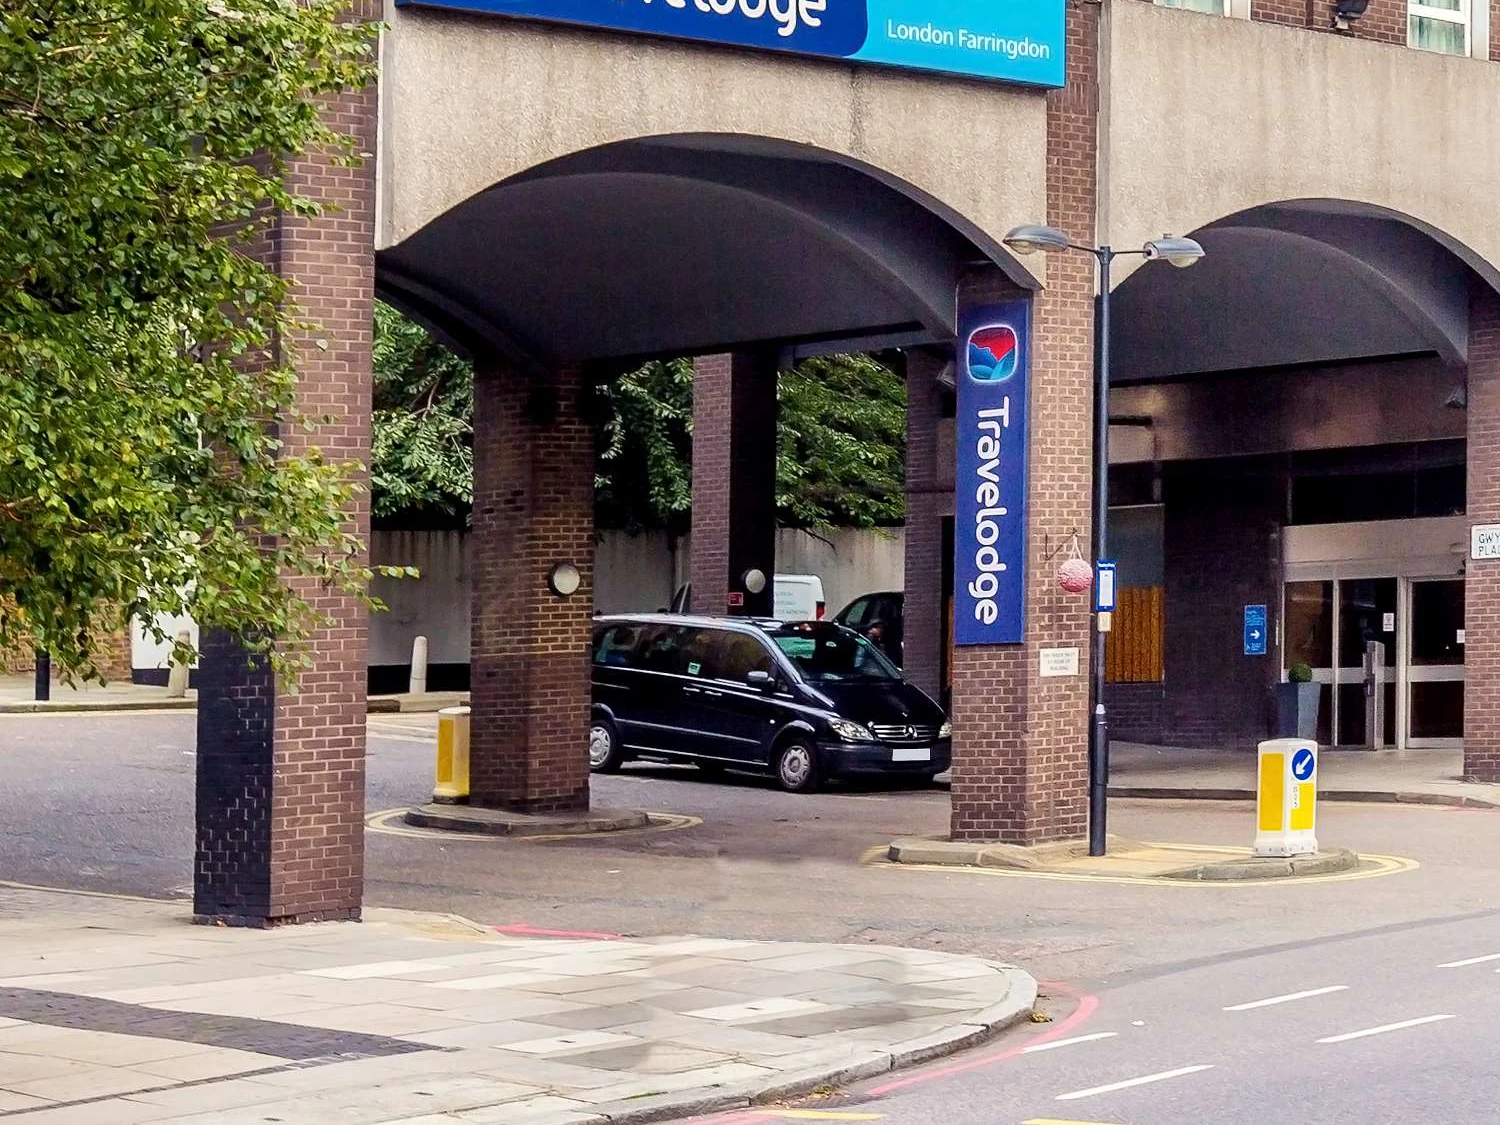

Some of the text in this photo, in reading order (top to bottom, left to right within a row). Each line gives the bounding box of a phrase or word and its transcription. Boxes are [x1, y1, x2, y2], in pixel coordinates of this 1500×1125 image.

[887, 19, 1051, 60] London Farringdon
[967, 396, 1010, 625] Travelodge
